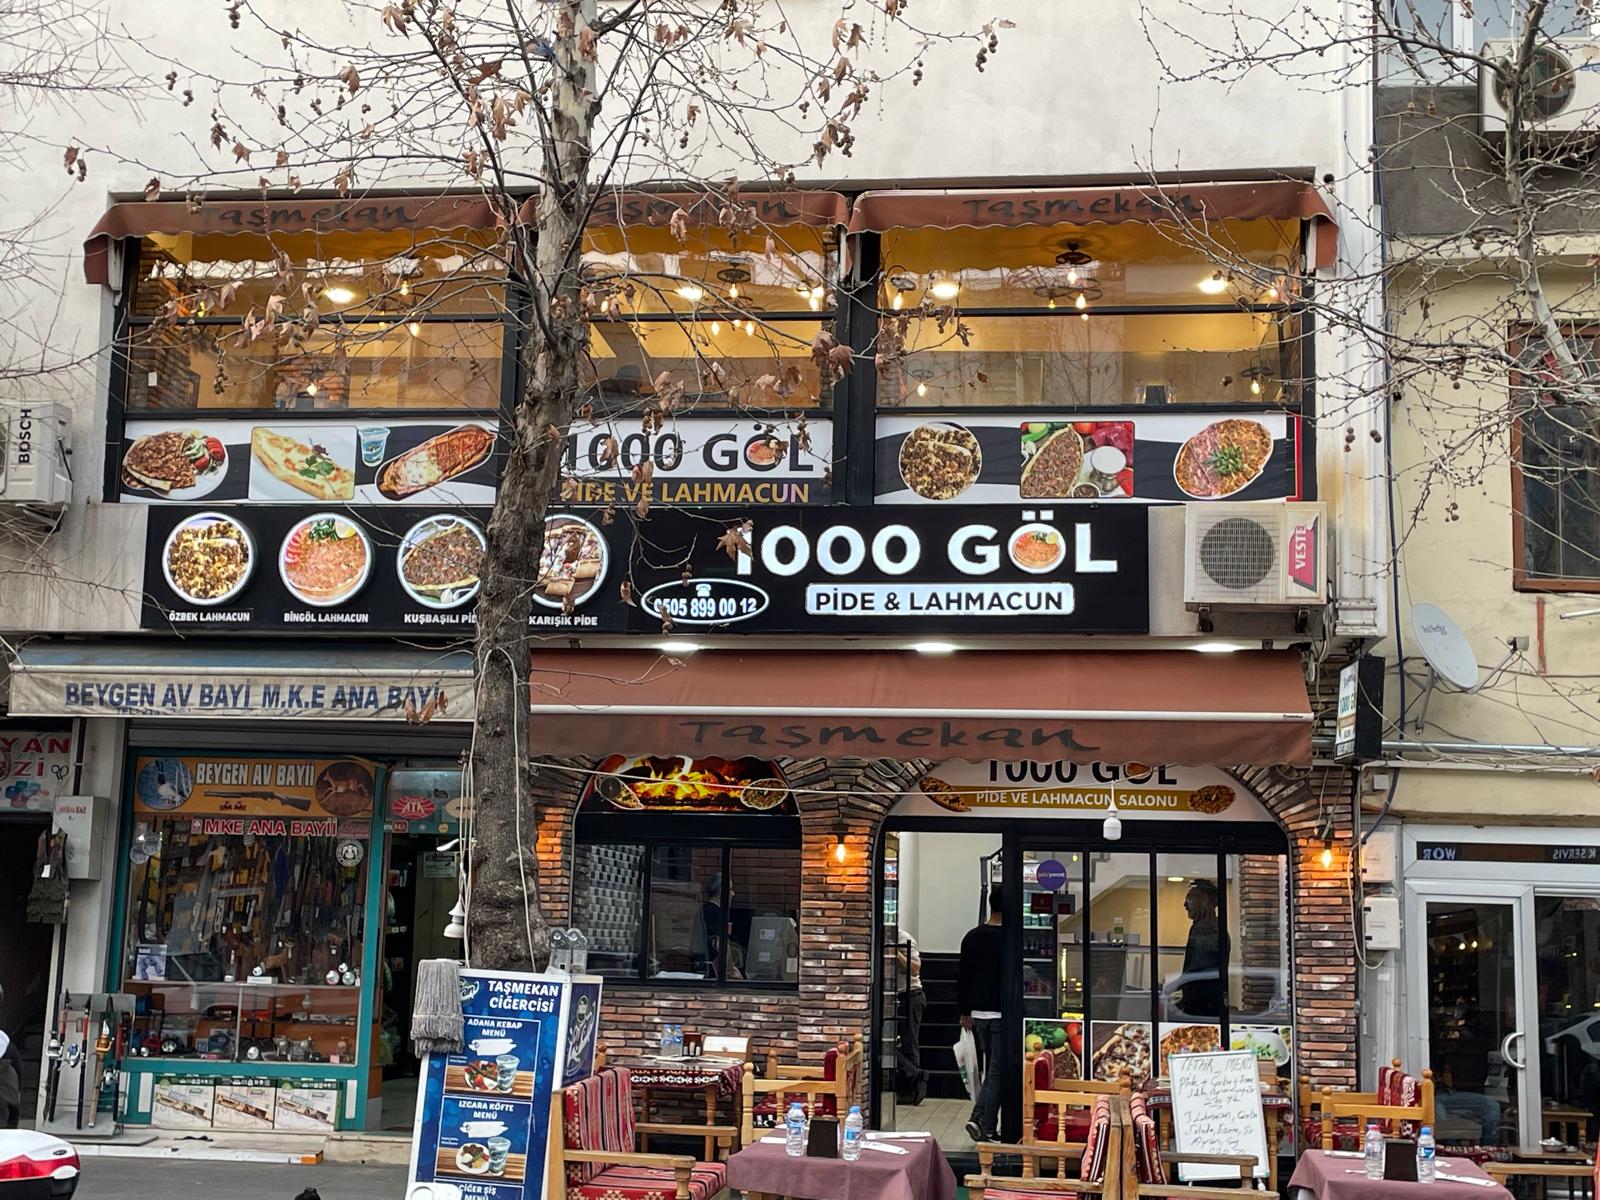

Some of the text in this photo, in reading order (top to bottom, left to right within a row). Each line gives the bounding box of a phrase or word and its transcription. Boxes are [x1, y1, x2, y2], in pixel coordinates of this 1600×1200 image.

[18, 409, 32, 464] BOSCH
[567, 423, 814, 472] 1000 GÖL
[623, 482, 654, 502] VE
[661, 483, 809, 503] LAHMACUN
[736, 509, 1119, 577] 1000 GÖL
[690, 597, 716, 617] 899
[719, 597, 737, 616] 00
[739, 597, 757, 613] 12
[814, 588, 1063, 612] PİDE & LAHMACUN
[169, 609, 250, 622] ÖZBEK LAHMACUN
[283, 610, 369, 623] BİNGÖL LAHMACUN
[403, 611, 478, 625] KUŞBAŞILI PİD
[528, 614, 598, 628] KARIŞIK PİDE
[65, 682, 156, 708] BEYGEN
[161, 683, 194, 708] AV
[261, 684, 326, 709] M.K.E
[331, 685, 379, 710] ANA
[195, 762, 249, 785] BEYGEN
[252, 763, 274, 786] AV
[989, 759, 1078, 783] 1000
[976, 789, 1178, 807] PİDE VE LAHMACUN SALONU
[204, 818, 245, 835] MKE
[248, 819, 287, 836] ANA
[487, 980, 559, 997] TAŞMEKAN
[489, 996, 554, 1013] CİĞERCİSİ
[467, 1018, 523, 1030] ADANA KEBAP
[481, 1027, 506, 1037] MENÜ
[458, 1100, 514, 1112] IZGARA KÖFTE
[472, 1110, 498, 1119] MENÜ
